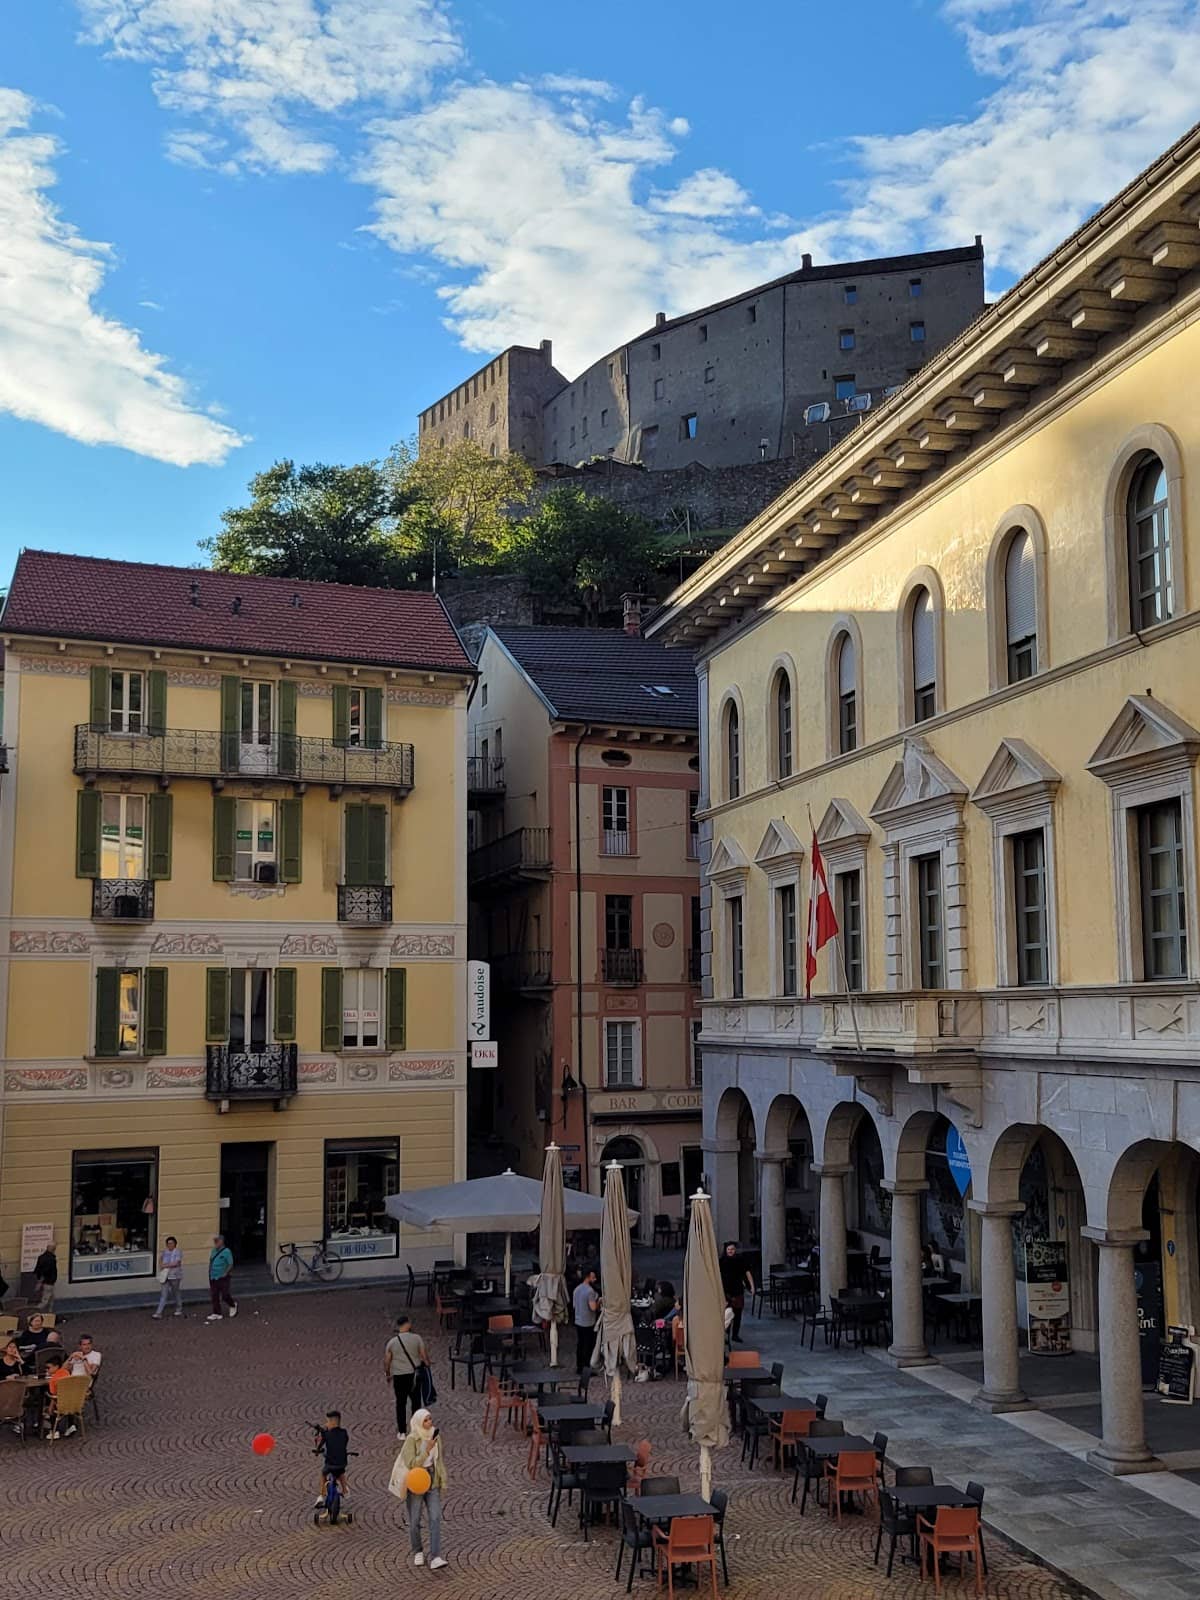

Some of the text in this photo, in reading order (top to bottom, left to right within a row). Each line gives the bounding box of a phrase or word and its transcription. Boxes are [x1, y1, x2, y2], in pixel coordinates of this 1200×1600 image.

[474, 968, 484, 1019] vaudoise
[609, 1097, 637, 1110] BAR
[1139, 1317, 1156, 1329] int
